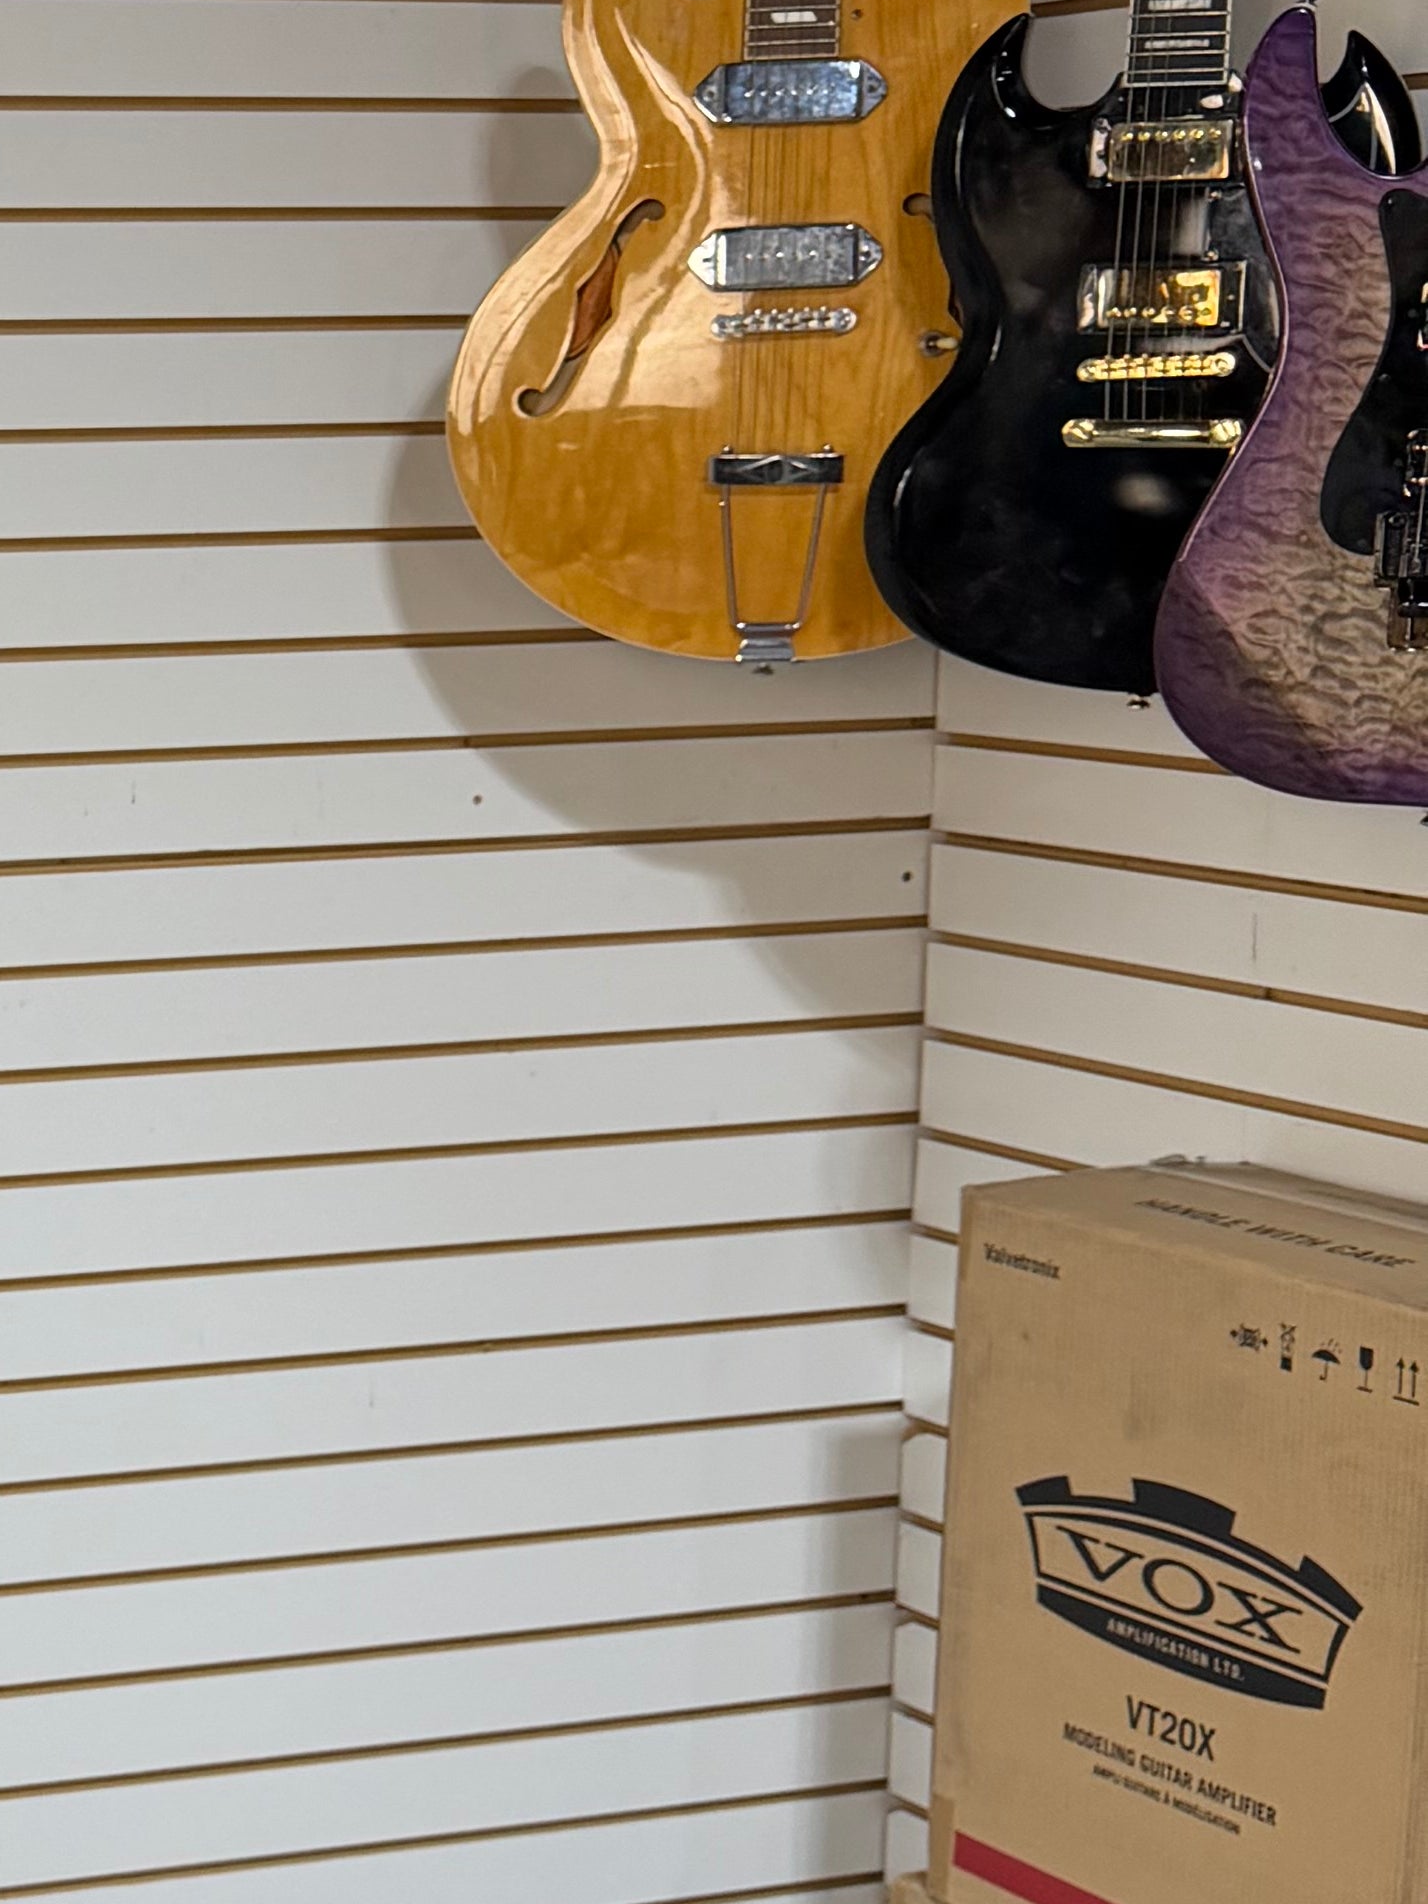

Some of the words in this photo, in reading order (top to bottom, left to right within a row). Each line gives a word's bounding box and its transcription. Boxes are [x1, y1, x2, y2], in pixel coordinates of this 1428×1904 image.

[1245, 1223, 1334, 1249] WITH
[1324, 1243, 1415, 1270] CARE
[1055, 1525, 1303, 1655] VOX
[1106, 1617, 1210, 1671] AMPLIFICATION
[1125, 1694, 1217, 1763] VT20X
[1062, 1722, 1136, 1767] MODELING
[1139, 1753, 1194, 1791] GUITAR
[1196, 1778, 1277, 1827] AMPLIFIER
